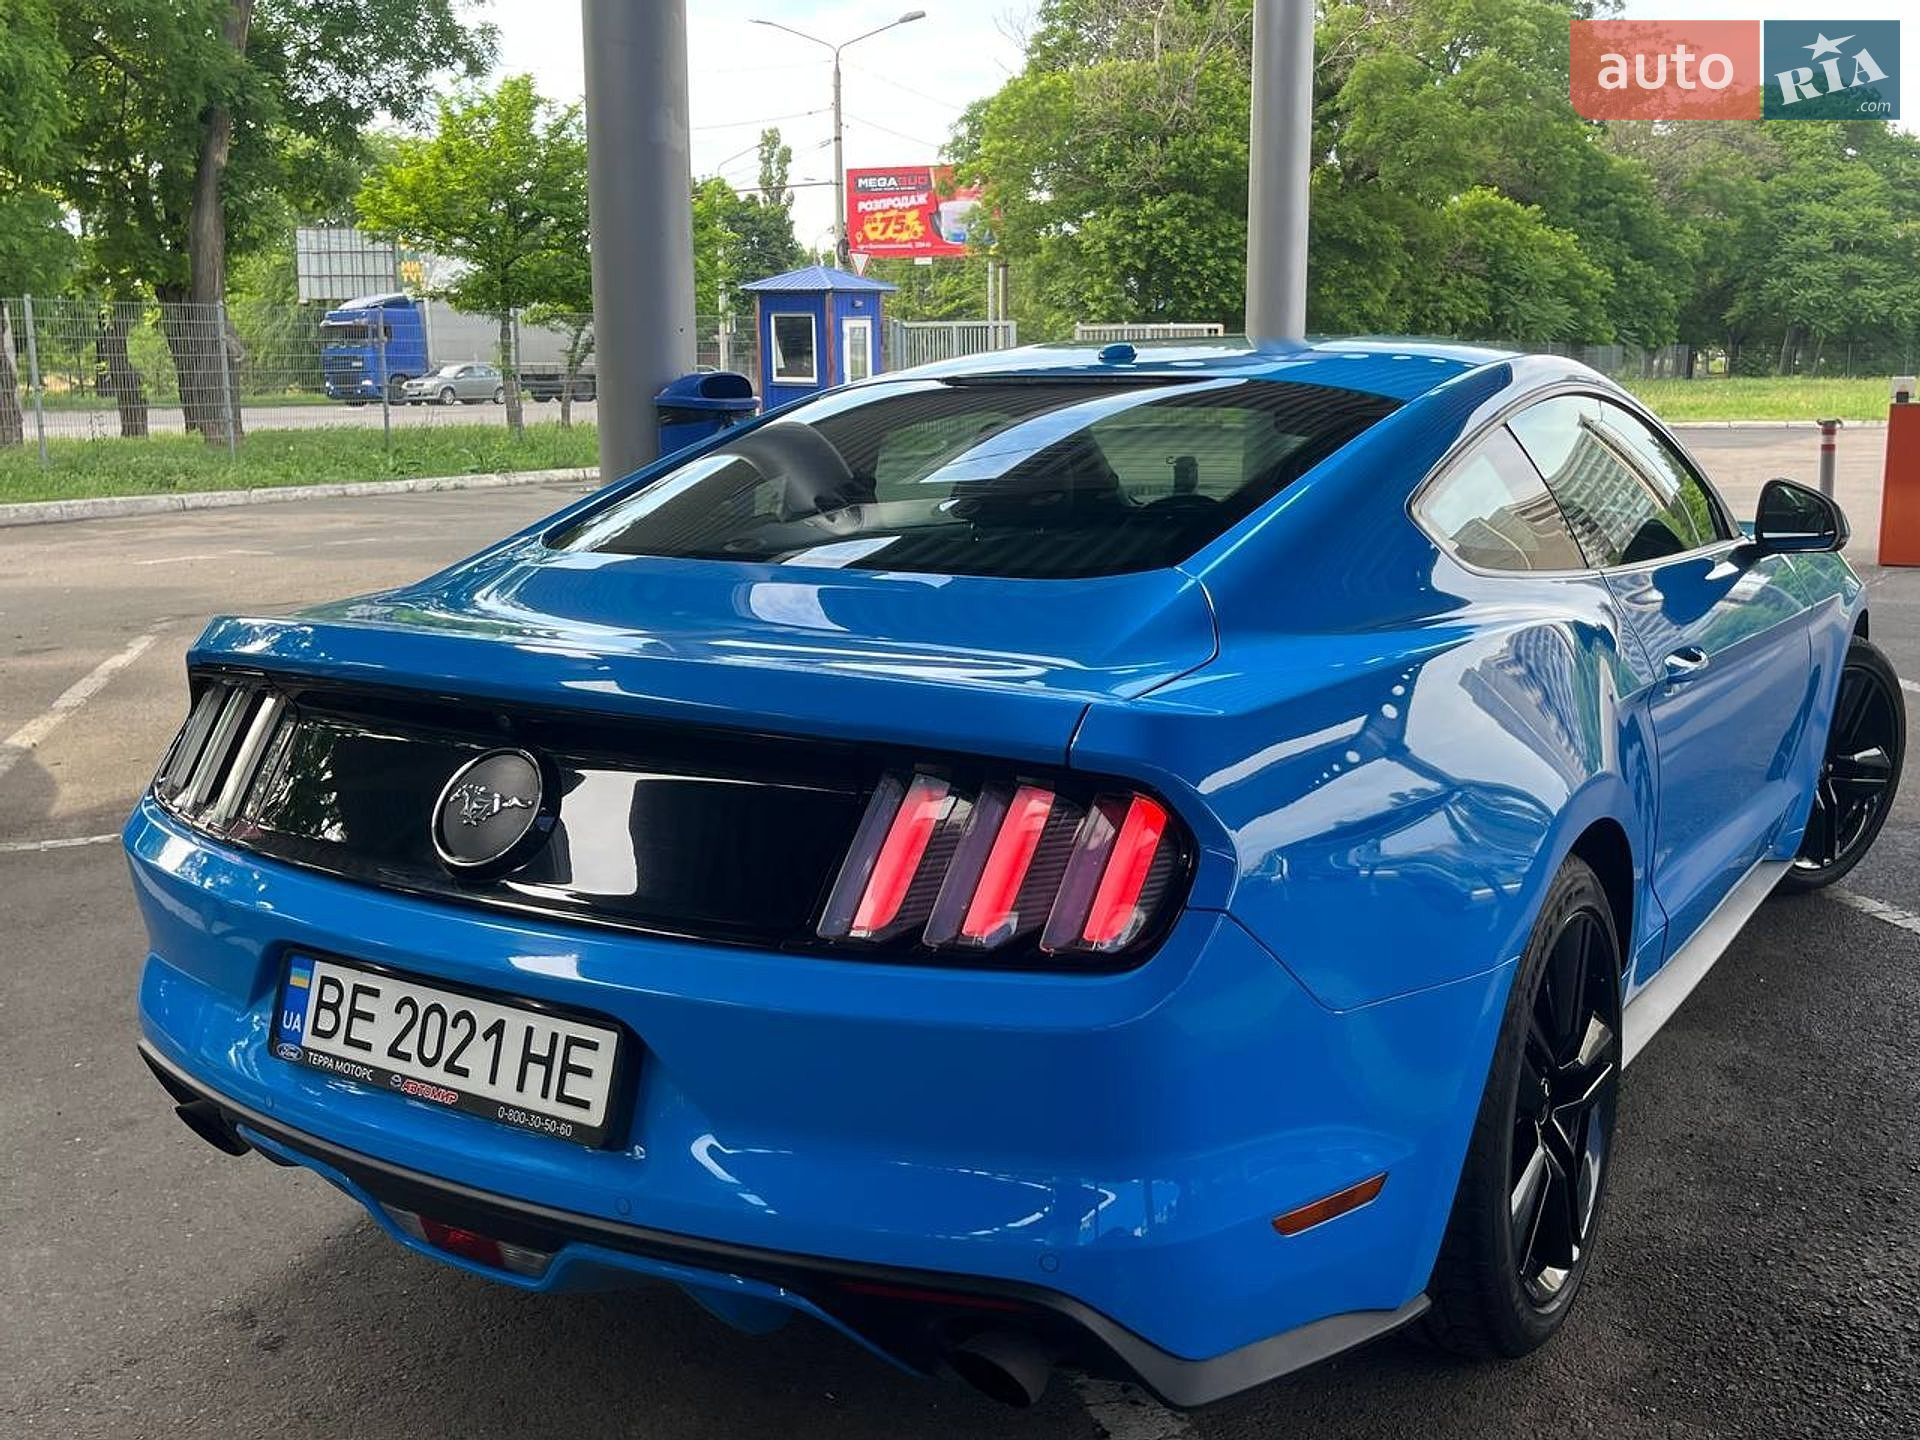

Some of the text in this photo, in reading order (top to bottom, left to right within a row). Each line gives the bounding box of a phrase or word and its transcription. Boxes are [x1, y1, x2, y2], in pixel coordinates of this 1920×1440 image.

[282, 1010, 301, 1032] UA
[279, 1045, 301, 1060] Ford
[311, 975, 600, 1110] BE 2021 HE
[306, 1052, 374, 1081] ТЕРРА МОТОРС
[401, 1078, 459, 1104] АВТОМИР
[498, 1106, 572, 1137] 0-800-30-50-60
